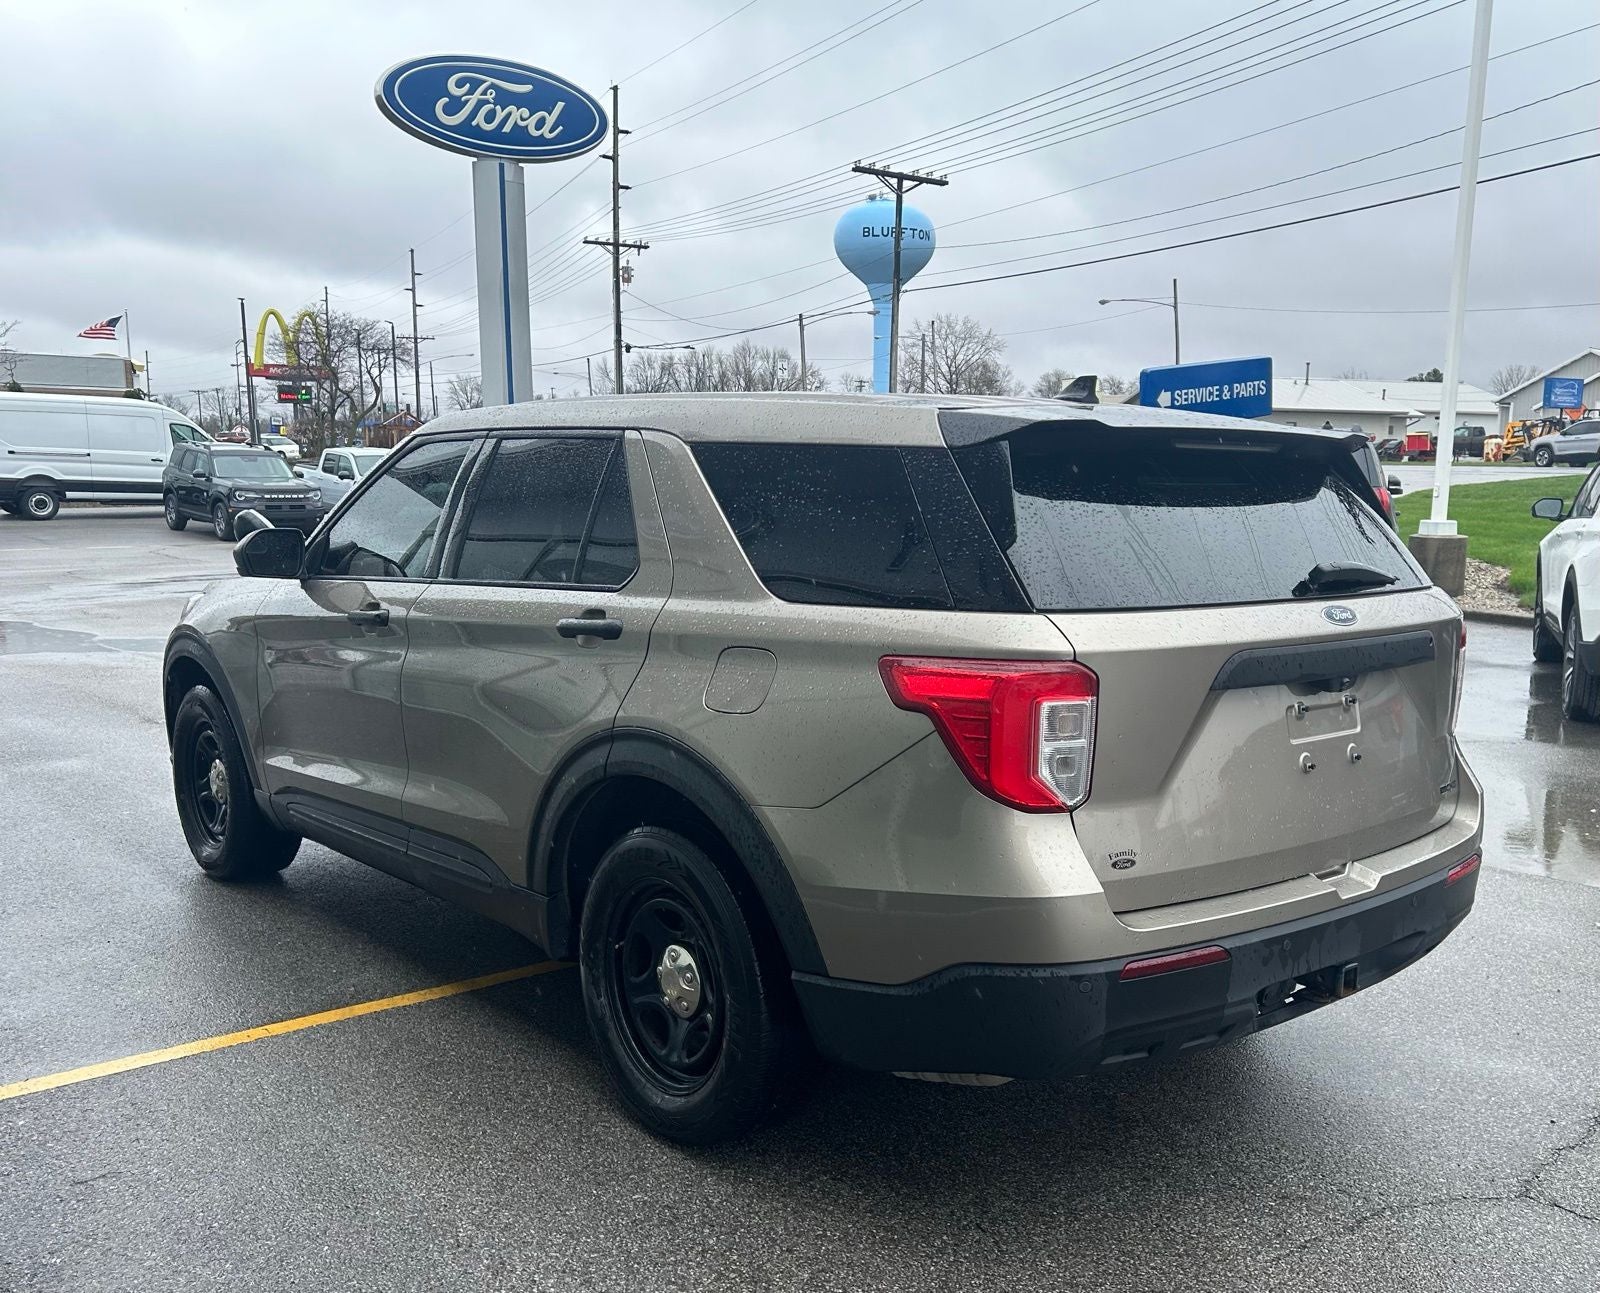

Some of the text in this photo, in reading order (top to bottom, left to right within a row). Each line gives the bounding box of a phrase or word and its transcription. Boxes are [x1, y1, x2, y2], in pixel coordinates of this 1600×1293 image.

[435, 72, 566, 139] Ford
[862, 226, 931, 241] BLUFFTON
[1174, 380, 1267, 406] SERVICE & PARTS
[1331, 608, 1353, 620] Ford
[1108, 849, 1137, 860] Family
